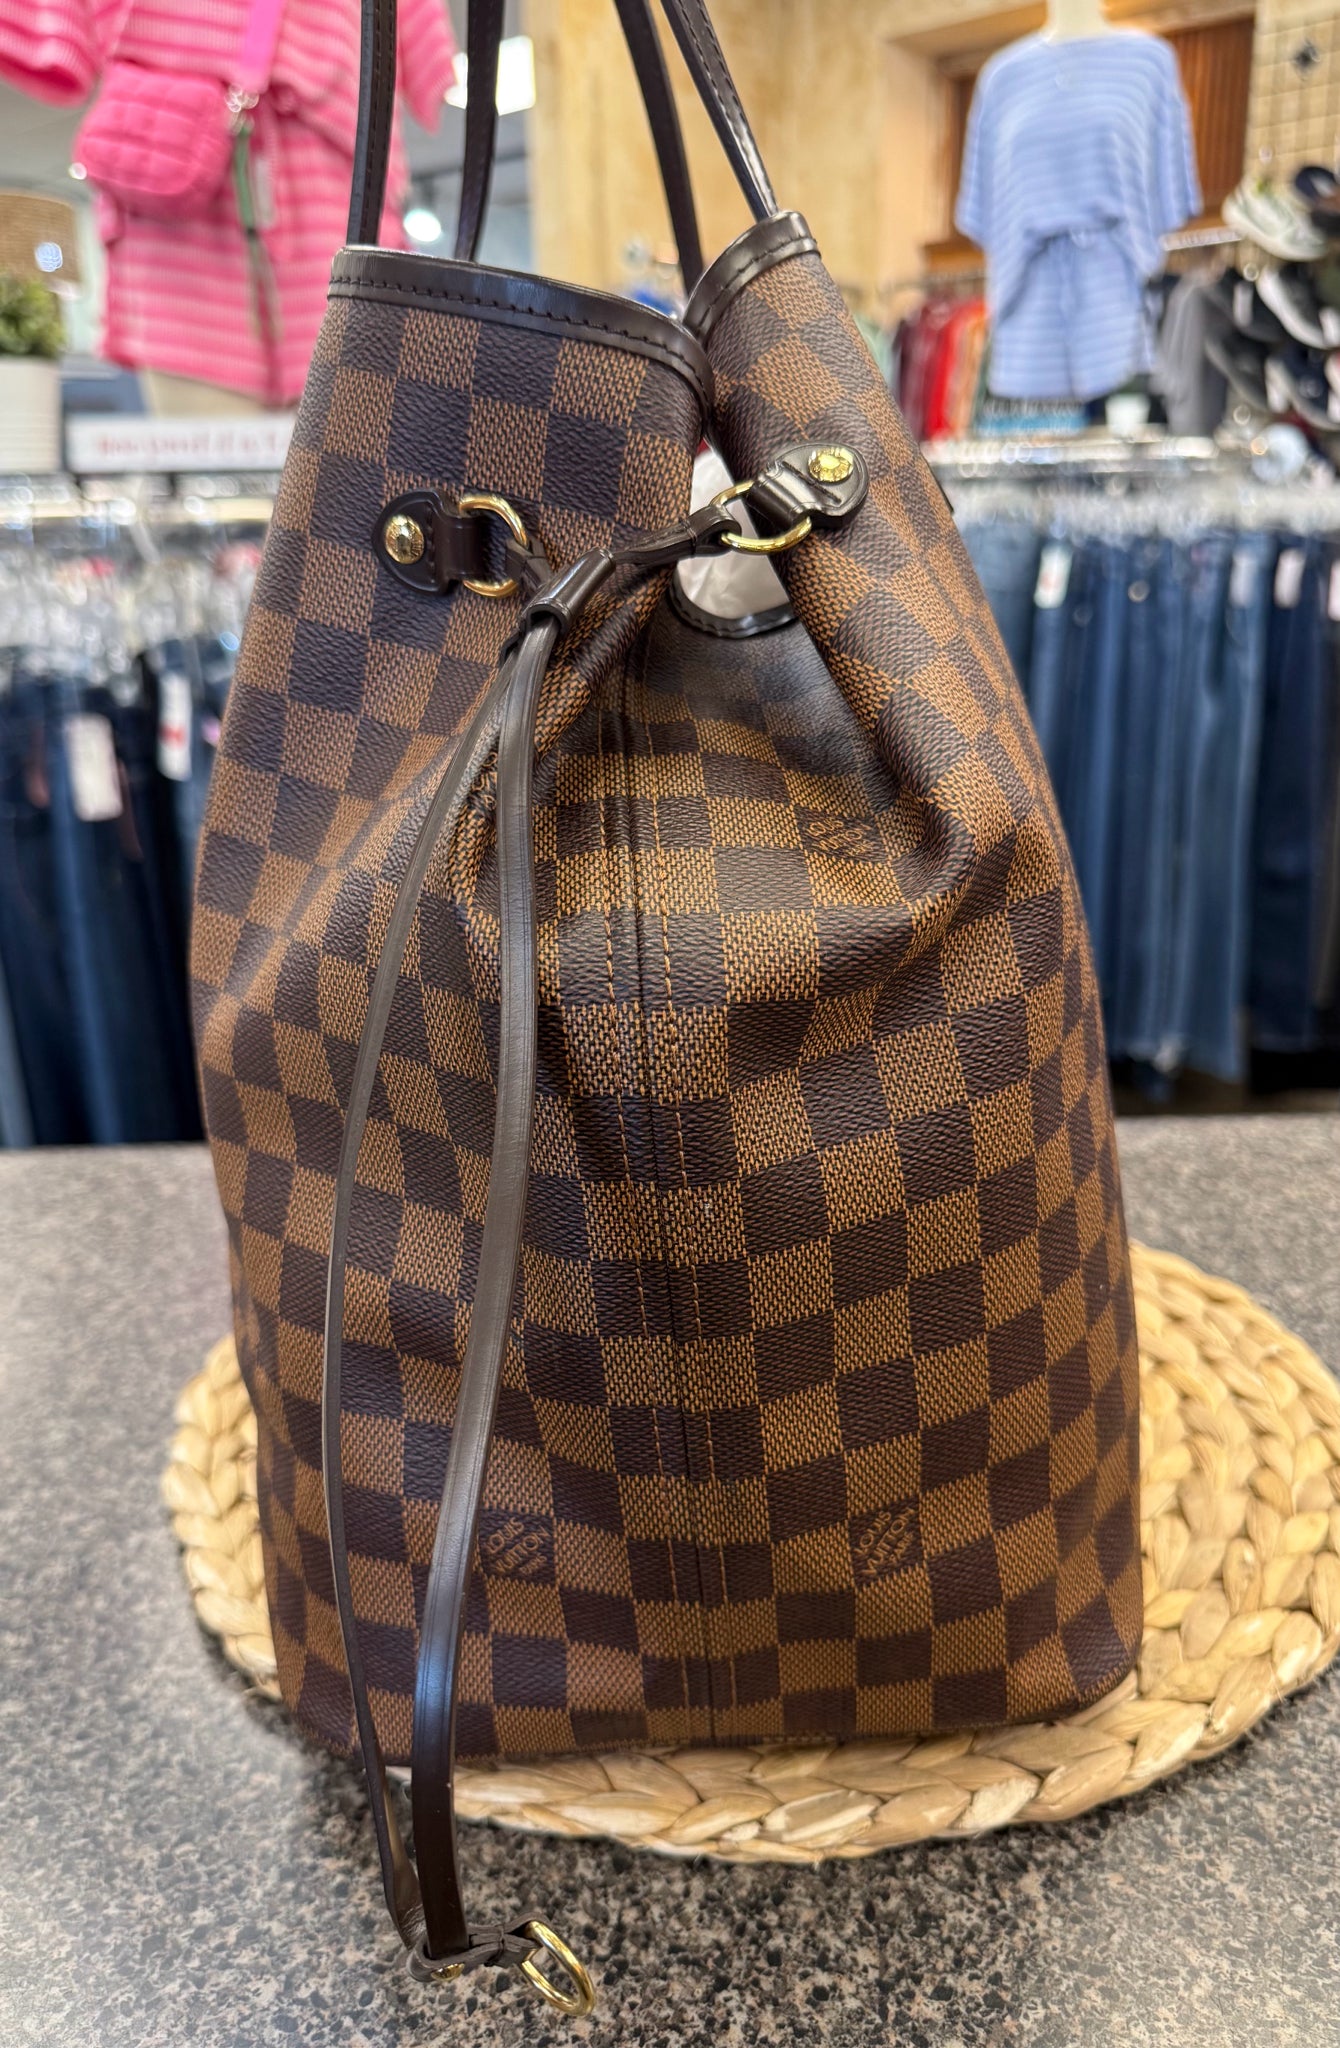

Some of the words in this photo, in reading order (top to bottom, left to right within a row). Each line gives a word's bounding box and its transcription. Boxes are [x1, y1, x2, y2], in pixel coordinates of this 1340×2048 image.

[485, 1517, 525, 1554] LOUIS
[495, 1525, 551, 1574] VUITTON
[854, 1511, 892, 1555] LOUIS
[861, 1507, 916, 1575] VUITTON
